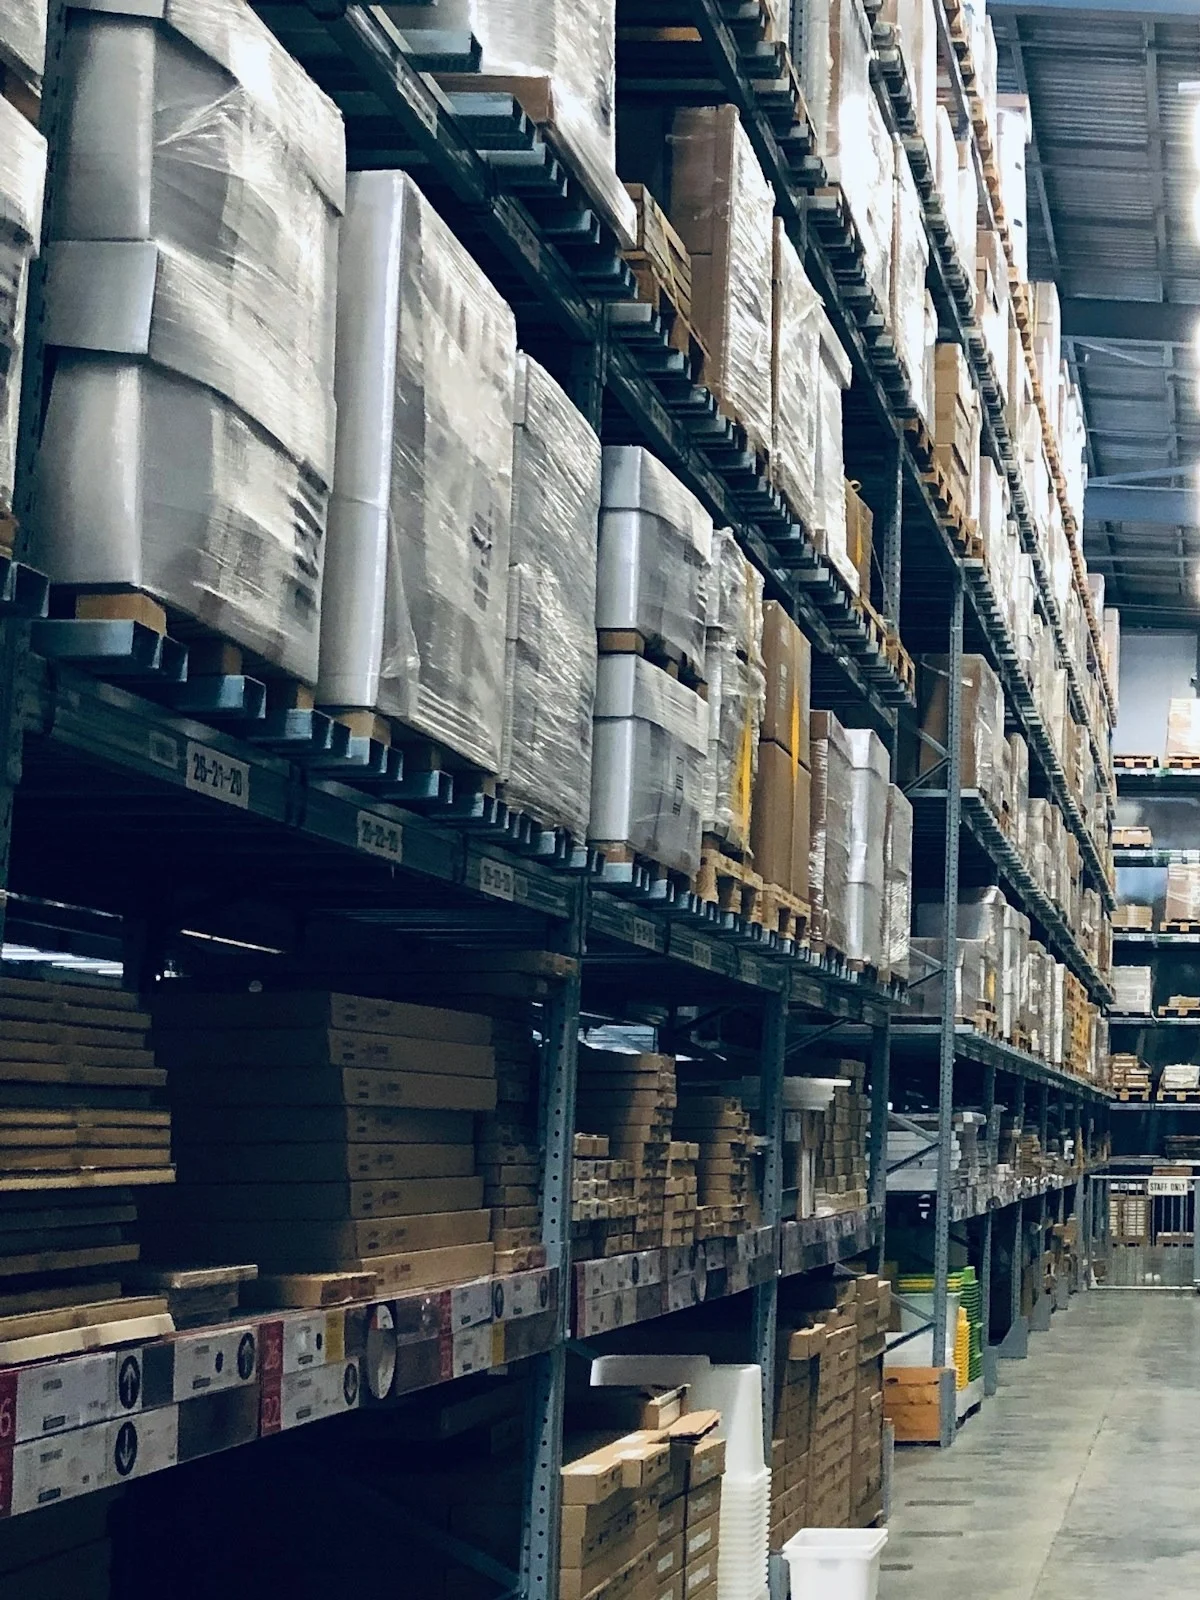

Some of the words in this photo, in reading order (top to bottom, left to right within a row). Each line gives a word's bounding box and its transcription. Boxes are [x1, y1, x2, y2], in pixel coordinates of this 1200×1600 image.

[193, 752, 242, 797] 26-21-20
[1150, 1182, 1168, 1192] STAFF
[1170, 1182, 1186, 1192] ONLY
